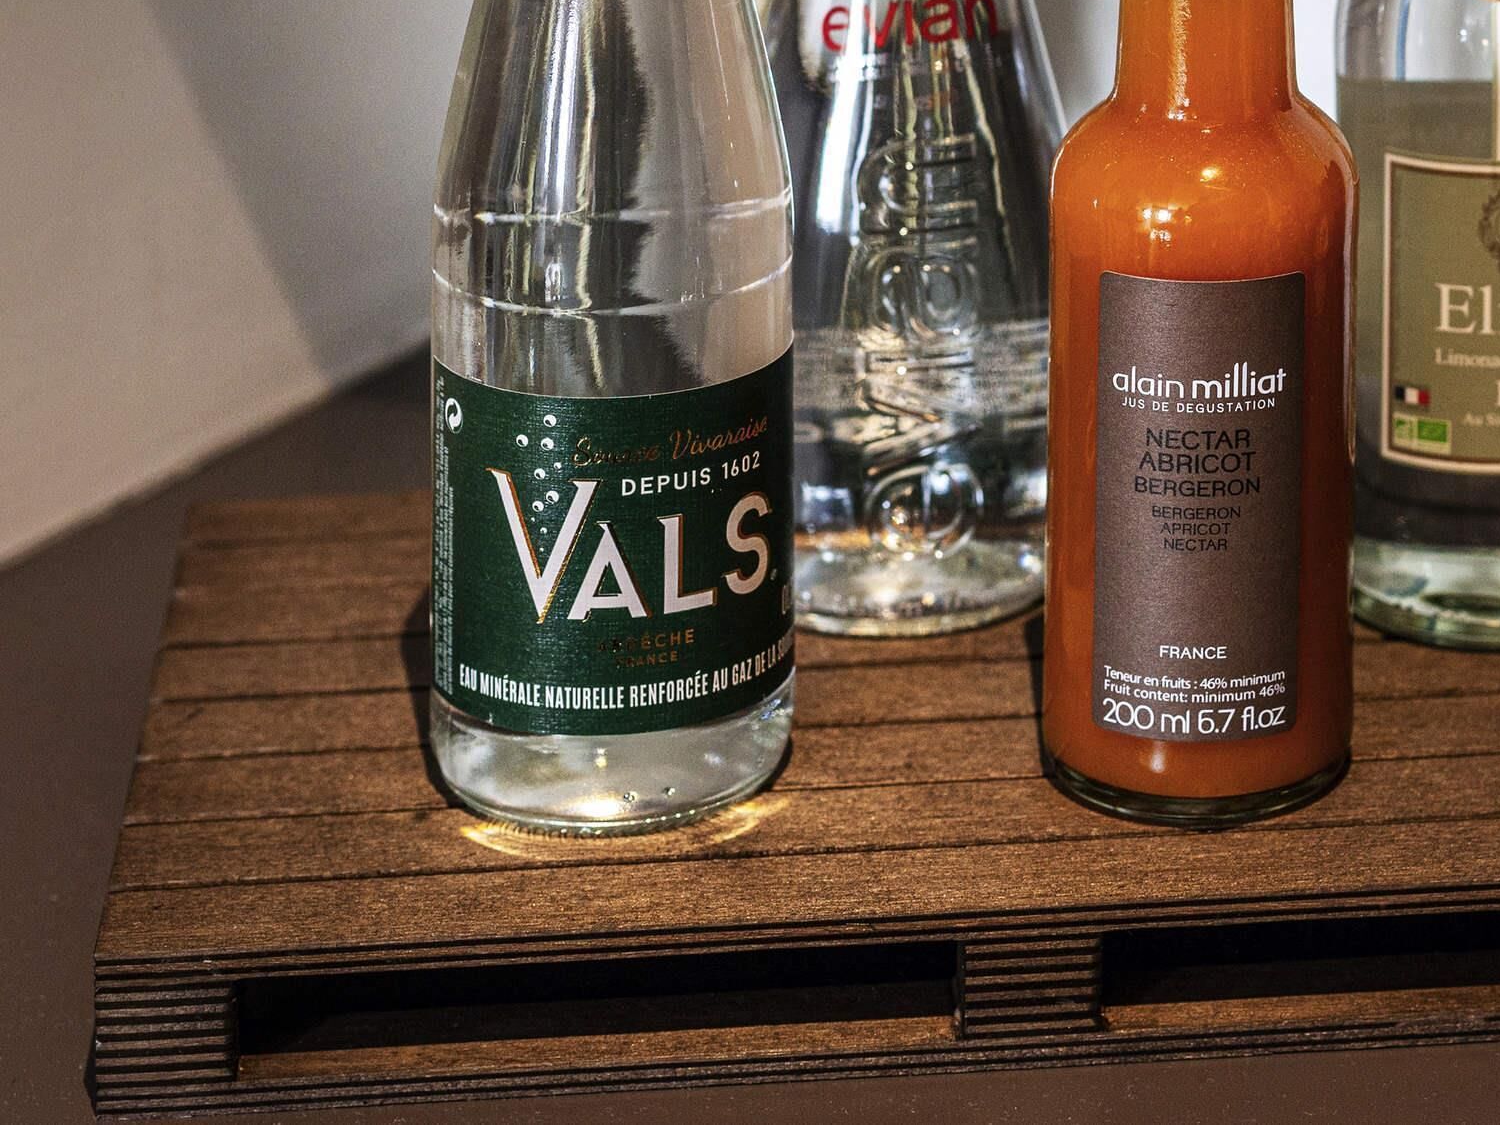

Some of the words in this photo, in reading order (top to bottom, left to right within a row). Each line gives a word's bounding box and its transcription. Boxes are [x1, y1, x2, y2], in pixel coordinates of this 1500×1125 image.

[1112, 365, 1184, 398] alain
[1192, 361, 1287, 399] milliat
[1122, 397, 1145, 409] JUS
[1152, 402, 1169, 412] DE
[1176, 397, 1276, 413] DEGUSTATION
[1146, 428, 1250, 450] NECTAR
[621, 467, 711, 497] DEPUIS
[721, 450, 761, 480] 1602
[1139, 451, 1257, 474] ABRICOT
[1134, 475, 1261, 497] BERGERON
[1151, 505, 1241, 520] BERGERON
[1160, 522, 1231, 536] APRICOT
[485, 466, 773, 625] VALS
[1163, 538, 1228, 551] NECTAR
[1159, 645, 1228, 660] FRANCE
[459, 663, 478, 692] EAU
[480, 671, 541, 707] MINÉRALE
[545, 685, 625, 710] NATURELLE
[629, 670, 709, 708] RENFORCÉE
[712, 667, 729, 693] AU
[732, 658, 753, 686] GAZ
[754, 650, 766, 677] DE
[1103, 664, 1142, 684] Teneur
[1143, 676, 1159, 687] en
[1160, 675, 1192, 689] fruits
[1199, 677, 1228, 690] 46%
[1230, 670, 1286, 689] minimum
[1104, 679, 1131, 696] Fruit
[1133, 687, 1188, 703] content:
[1191, 689, 1256, 704] minimum
[1259, 682, 1286, 697] 46%
[1102, 697, 1155, 730] 200
[1160, 709, 1191, 734] ml
[1197, 708, 1236, 735] 6.7
